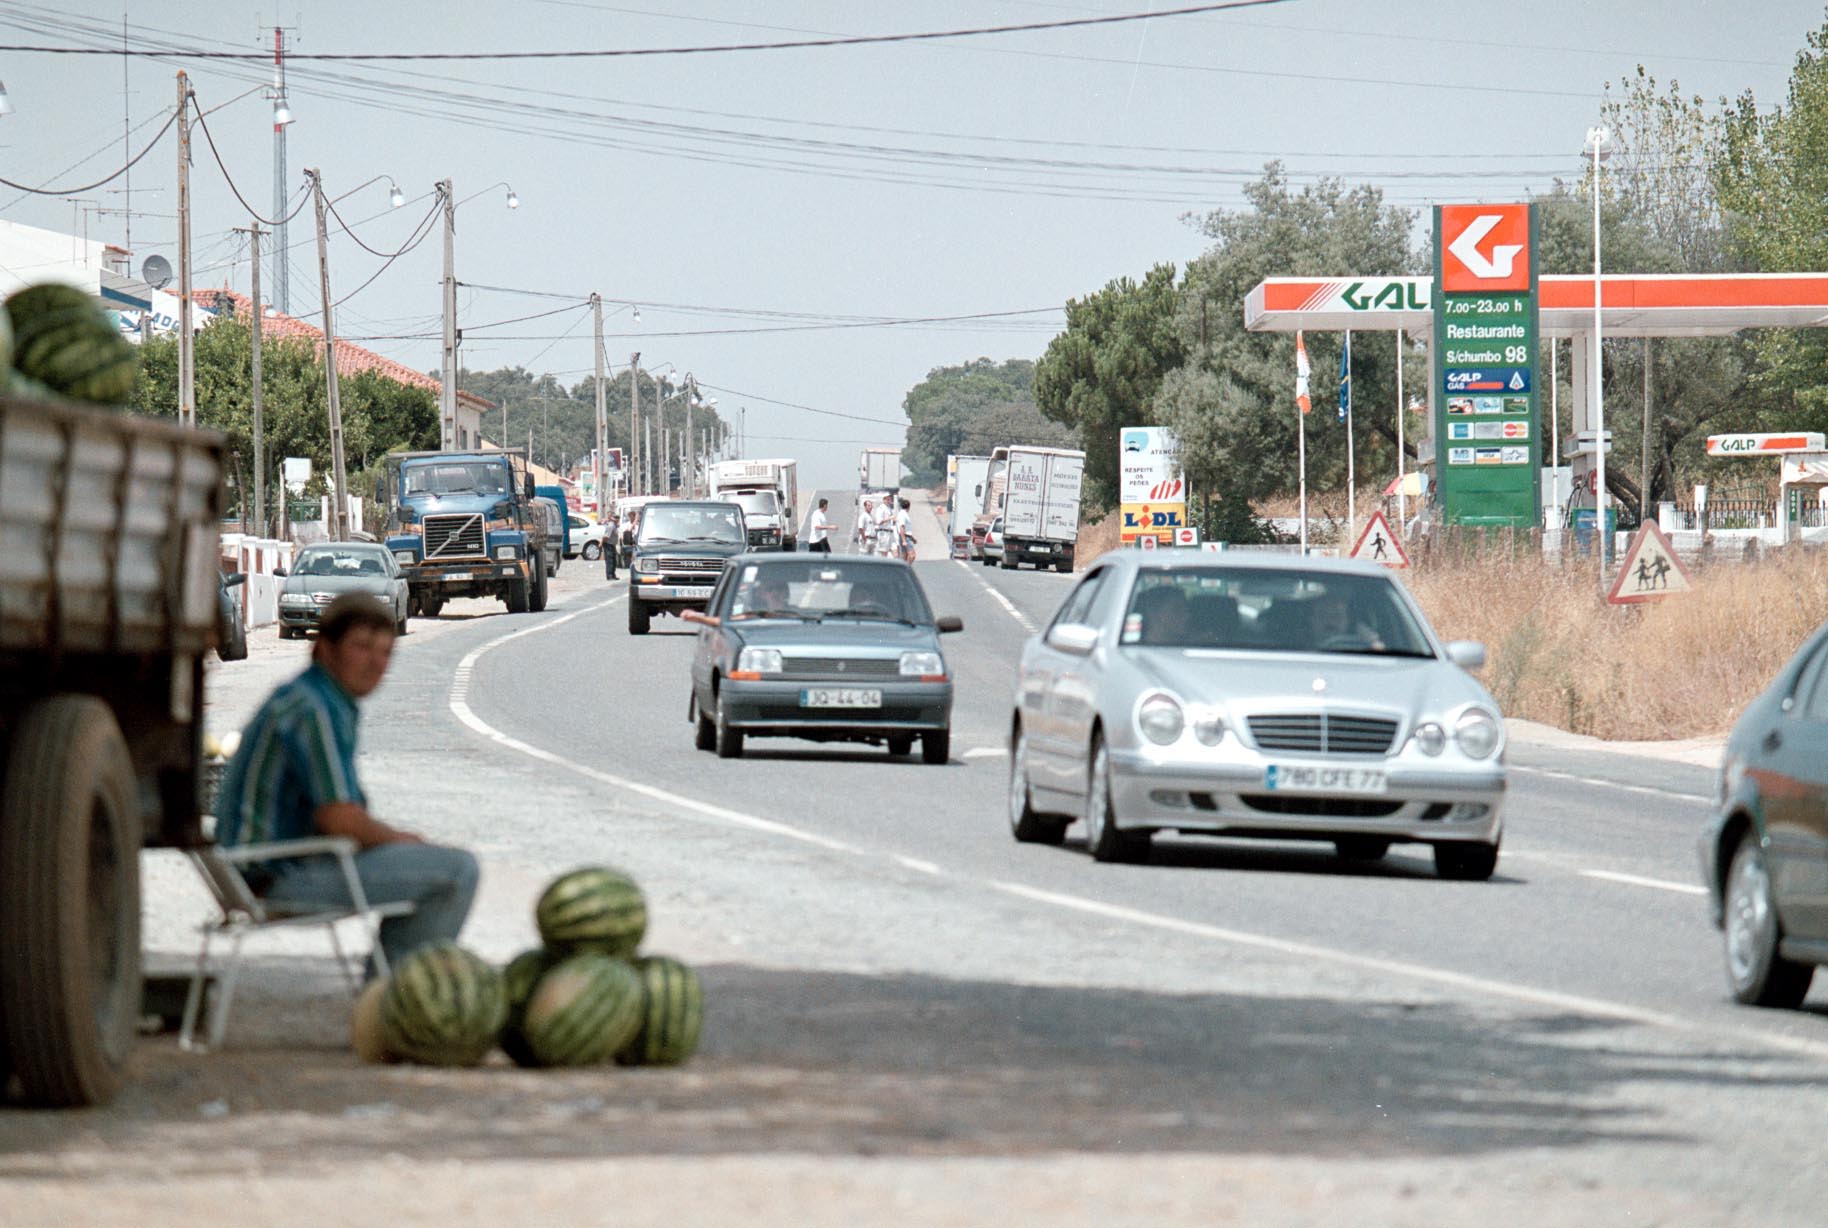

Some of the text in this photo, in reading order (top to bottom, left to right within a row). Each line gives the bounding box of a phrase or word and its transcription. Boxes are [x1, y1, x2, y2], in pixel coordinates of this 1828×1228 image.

[1341, 282, 1434, 310] GAL
[1514, 299, 1523, 312] h
[1447, 324, 1525, 339] Restaurante
[1446, 346, 1527, 363] S/chumbo 98
[1447, 373, 1482, 382] GALP
[1721, 439, 1756, 451] GALP
[1280, 765, 1316, 785] 780
[1359, 769, 1385, 789] 77
